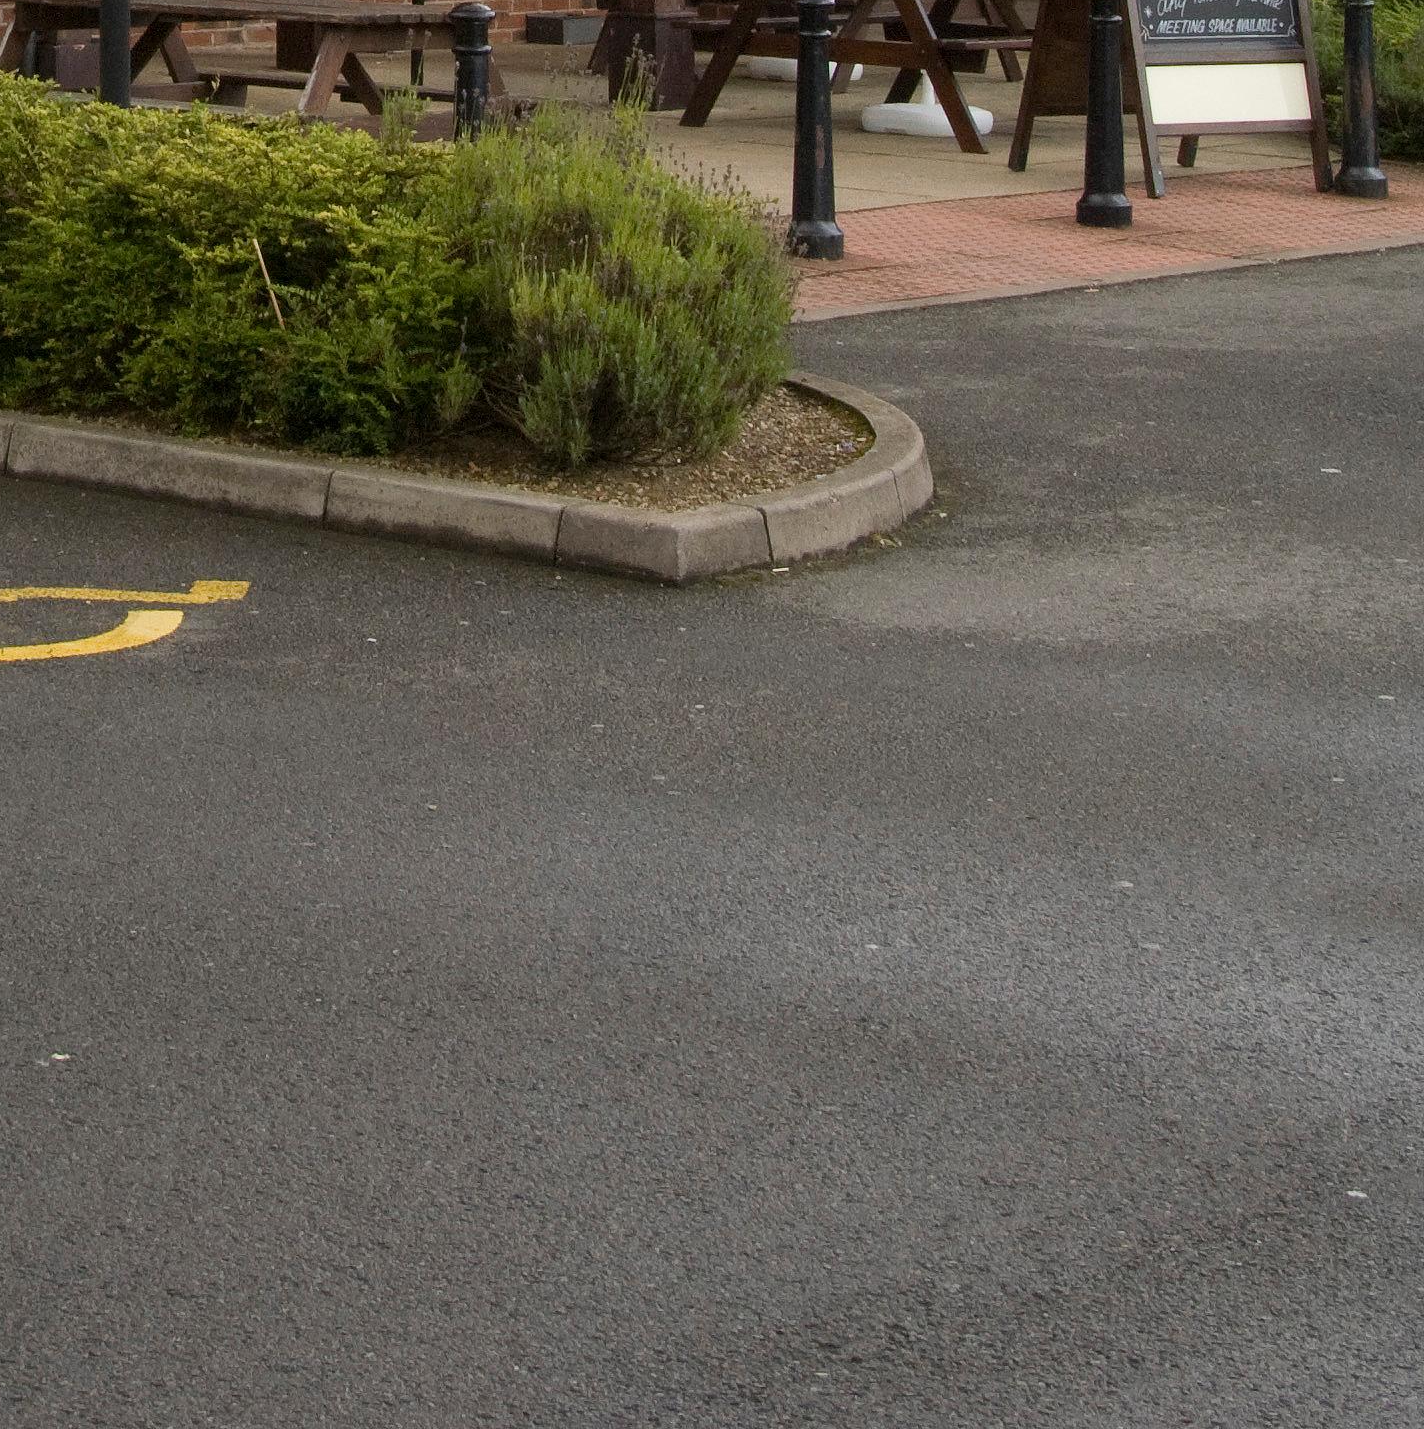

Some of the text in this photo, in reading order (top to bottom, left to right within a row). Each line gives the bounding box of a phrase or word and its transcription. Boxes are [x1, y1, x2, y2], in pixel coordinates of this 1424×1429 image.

[1156, 18, 1278, 34] MEETING SPACE AVAILABLE
